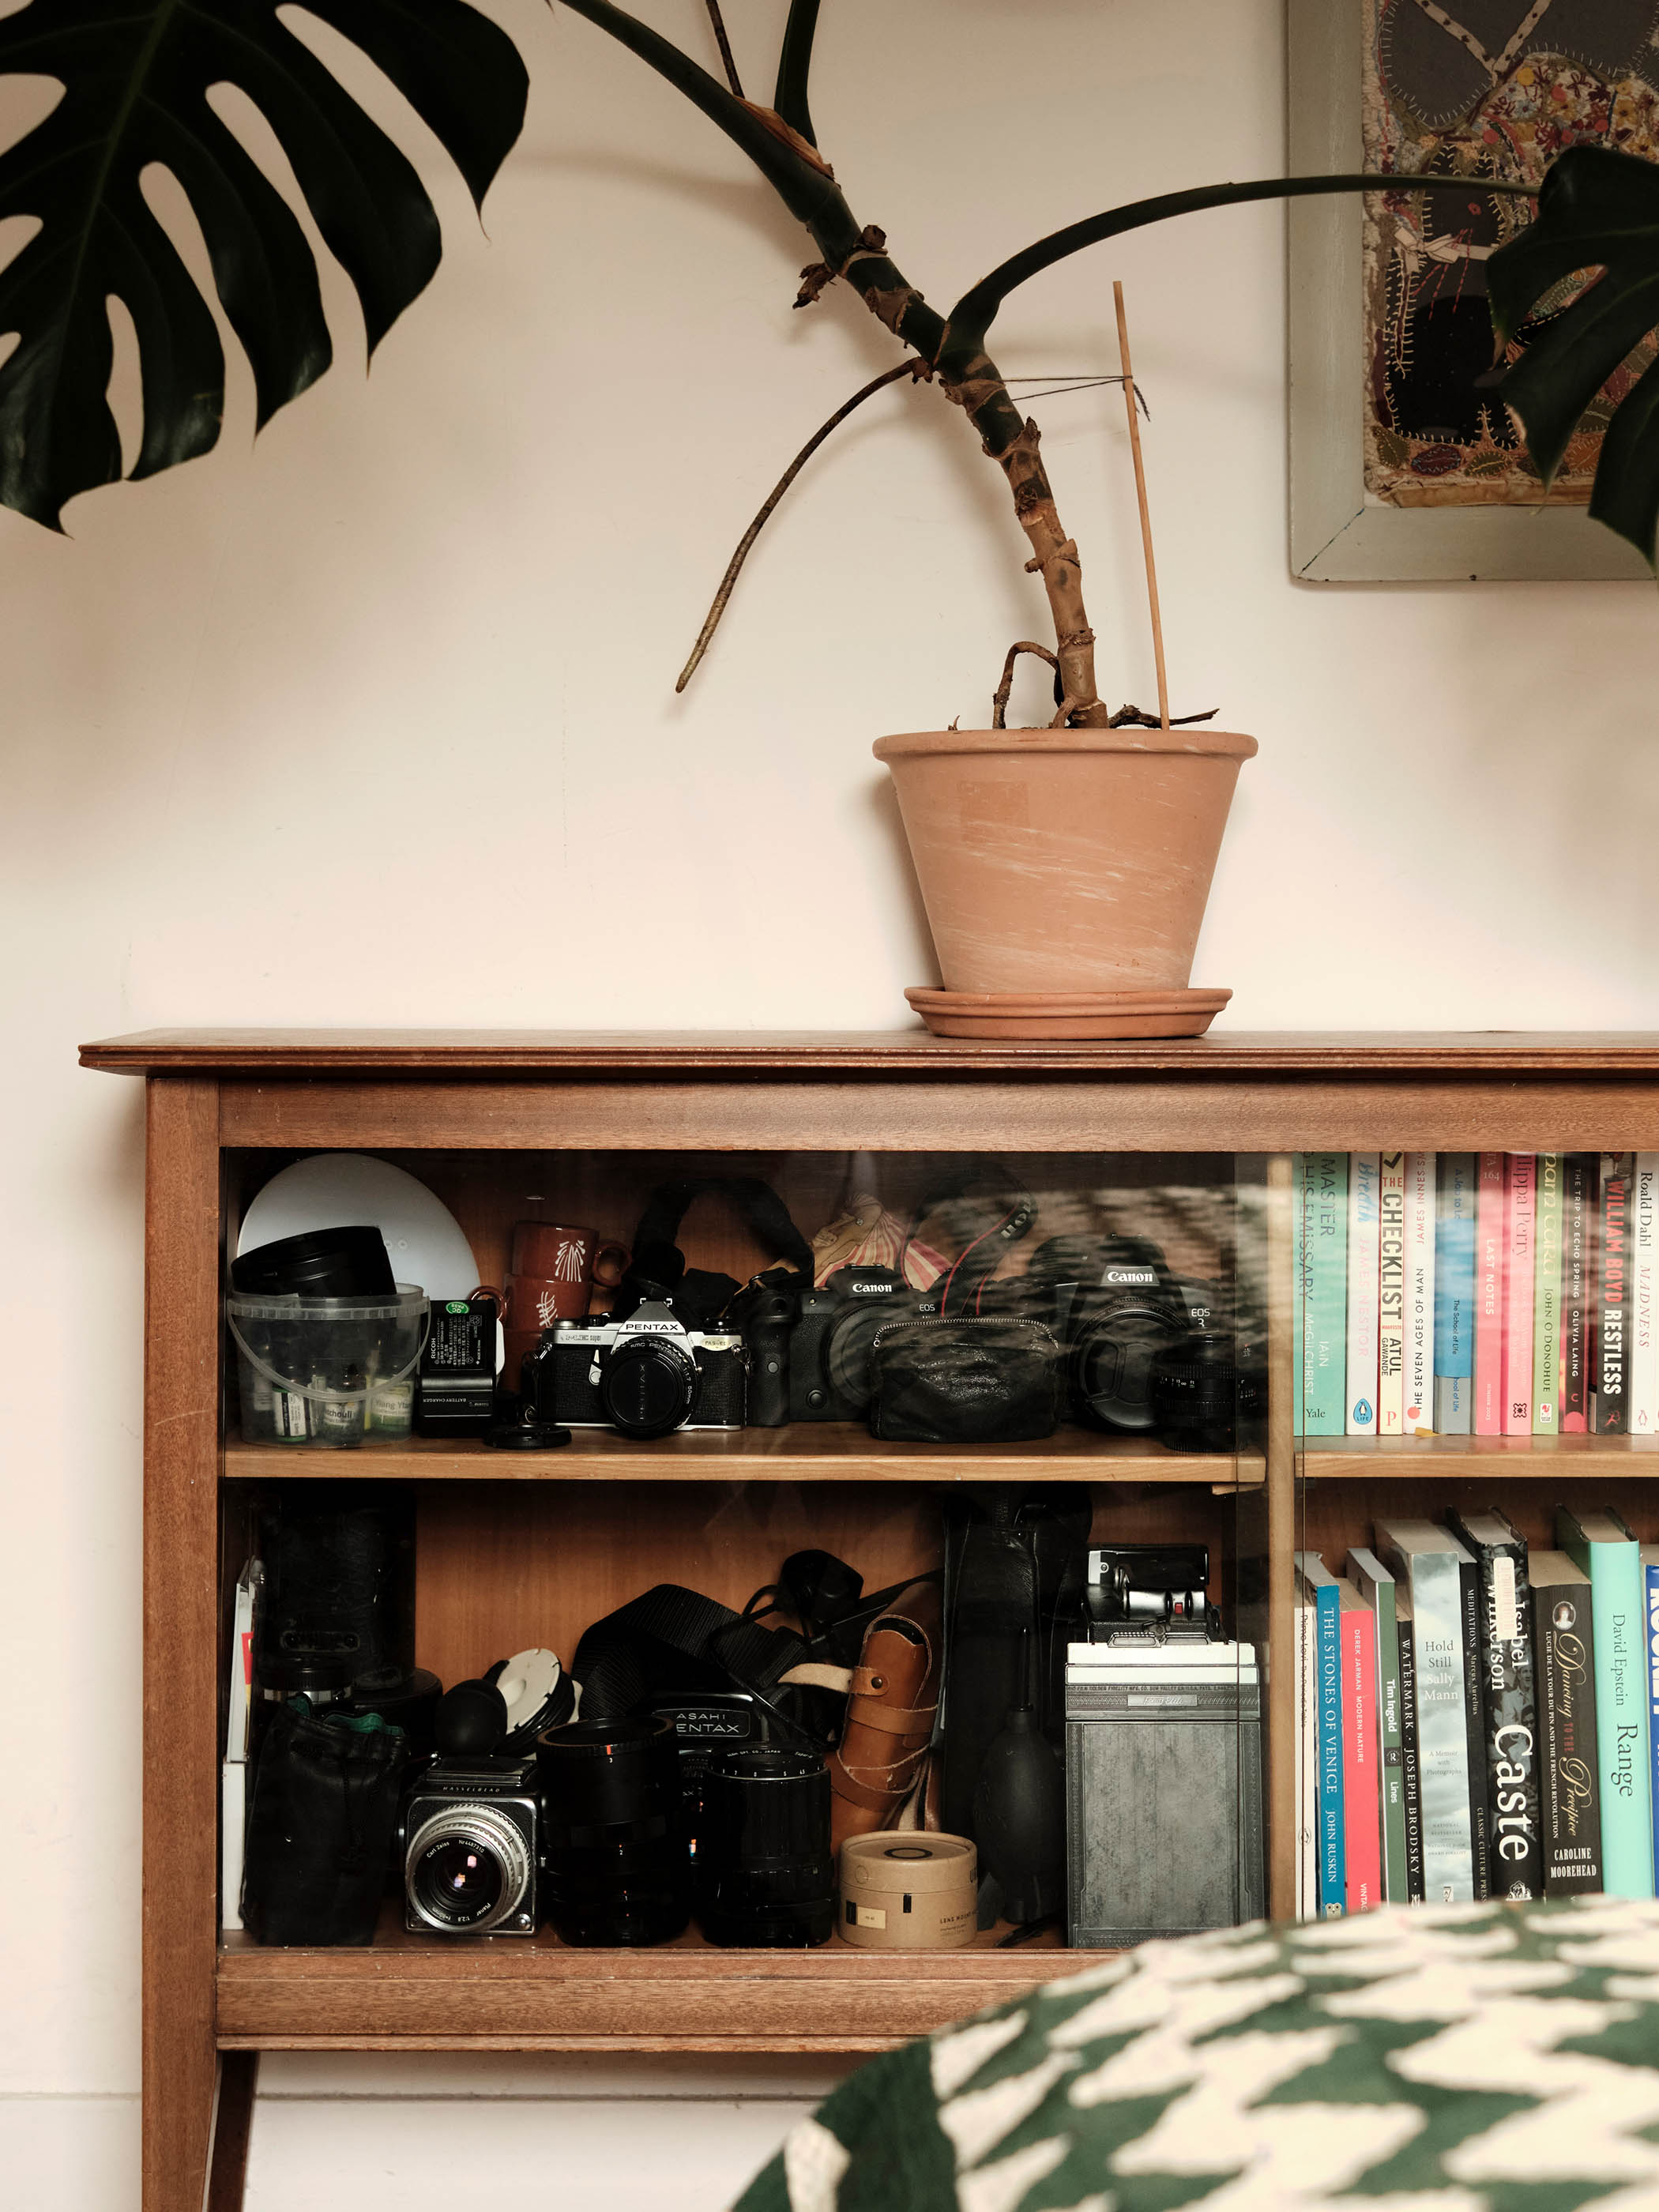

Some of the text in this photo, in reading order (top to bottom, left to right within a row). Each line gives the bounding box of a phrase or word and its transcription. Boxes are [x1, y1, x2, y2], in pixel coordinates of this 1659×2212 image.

[1382, 1177, 1402, 1187] THE
[1320, 1159, 1336, 1236] MASTER
[1416, 1171, 1425, 1245] JAMES INNES
[1512, 1213, 1531, 1259] Perry
[1574, 1216, 1581, 1228] TO
[1382, 1194, 1402, 1320] CHECKLIST
[1638, 1172, 1653, 1349] Roald Dahl MADNESS
[852, 1283, 892, 1292] Canon
[1108, 1271, 1153, 1282] Canon
[1416, 1269, 1424, 1294] MAN
[1485, 1239, 1495, 1315] LAST NOTES
[1603, 1181, 1624, 1395] WILLIAM BOYD RESTLESS
[1191, 1308, 1210, 1317] EOS
[1358, 1239, 1370, 1358] JAMES NESTOR
[1415, 1300, 1424, 1313] OF
[1544, 1288, 1553, 1318] JOHN
[1414, 1319, 1423, 1346] AGES
[1390, 1337, 1401, 1376] ATUL
[1414, 1352, 1423, 1386] SEVEN
[1306, 1409, 1326, 1418] Yale
[1467, 1589, 1477, 1648] MEDITATIONS
[1425, 1639, 1454, 1651] Hold
[1511, 1601, 1529, 1668] Isabel
[1428, 1657, 1452, 1668] Still
[1547, 1655, 1552, 1665] DE
[1547, 1666, 1553, 1676] LA
[1427, 1672, 1454, 1687] Sally
[1386, 1680, 1397, 1732] Tim Ingold
[1424, 1690, 1459, 1700] Mann
[1548, 1699, 1554, 1710] DU
[1611, 1614, 1638, 1796] David Epstein Range
[675, 1723, 739, 1732] ENTAX
[1554, 1631, 1592, 1836] Dancing TO THE Precipice
[1324, 1608, 1337, 1882] THE STONES OF VENICE JOHN RUSKIN
[1402, 1639, 1420, 1874] WATERMARK JOSEPH BRODSKY
[1494, 1725, 1533, 1860] Caste
[1554, 1847, 1592, 1860] CAROLINE
[1550, 1864, 1597, 1878] MOOREHEAD
[1360, 1883, 1368, 1911] VINTAG
